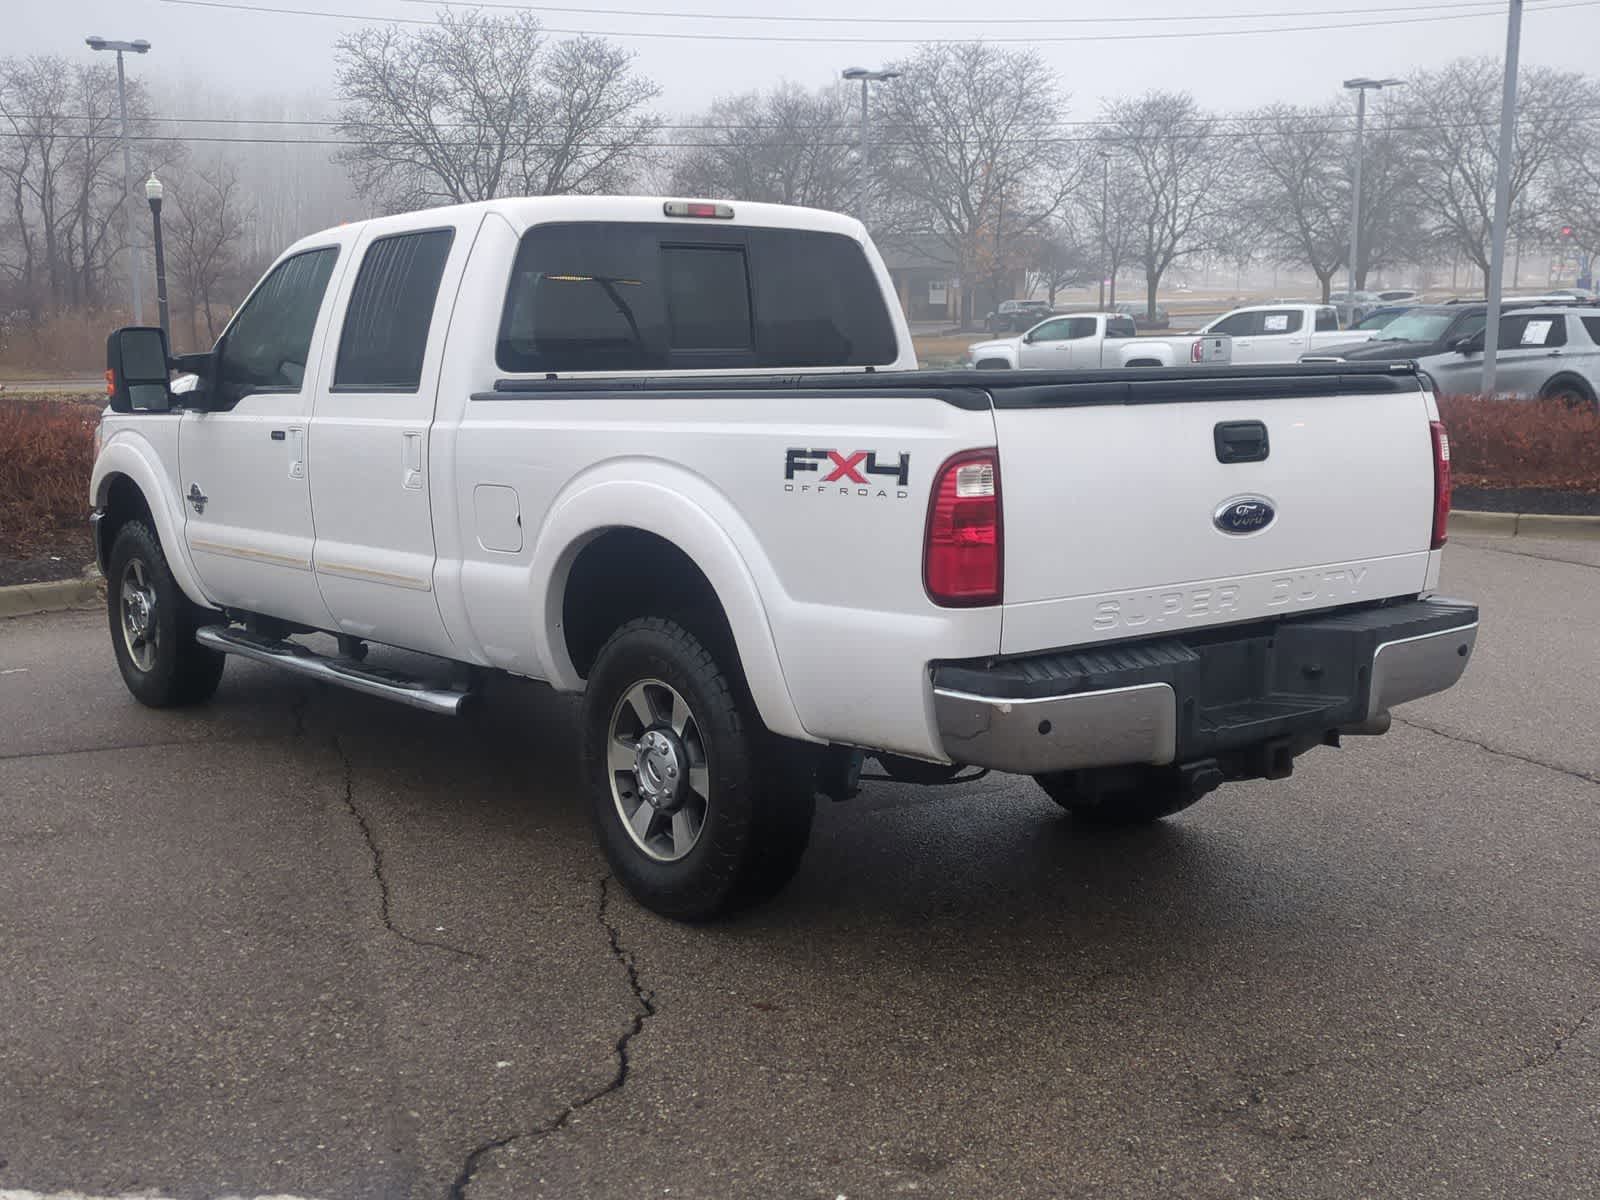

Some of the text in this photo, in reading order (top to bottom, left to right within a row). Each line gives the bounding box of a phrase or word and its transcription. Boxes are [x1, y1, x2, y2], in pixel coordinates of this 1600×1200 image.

[785, 447, 910, 486] FX4
[1232, 504, 1265, 526] Ford
[1091, 566, 1369, 631] SUPER DUTY
